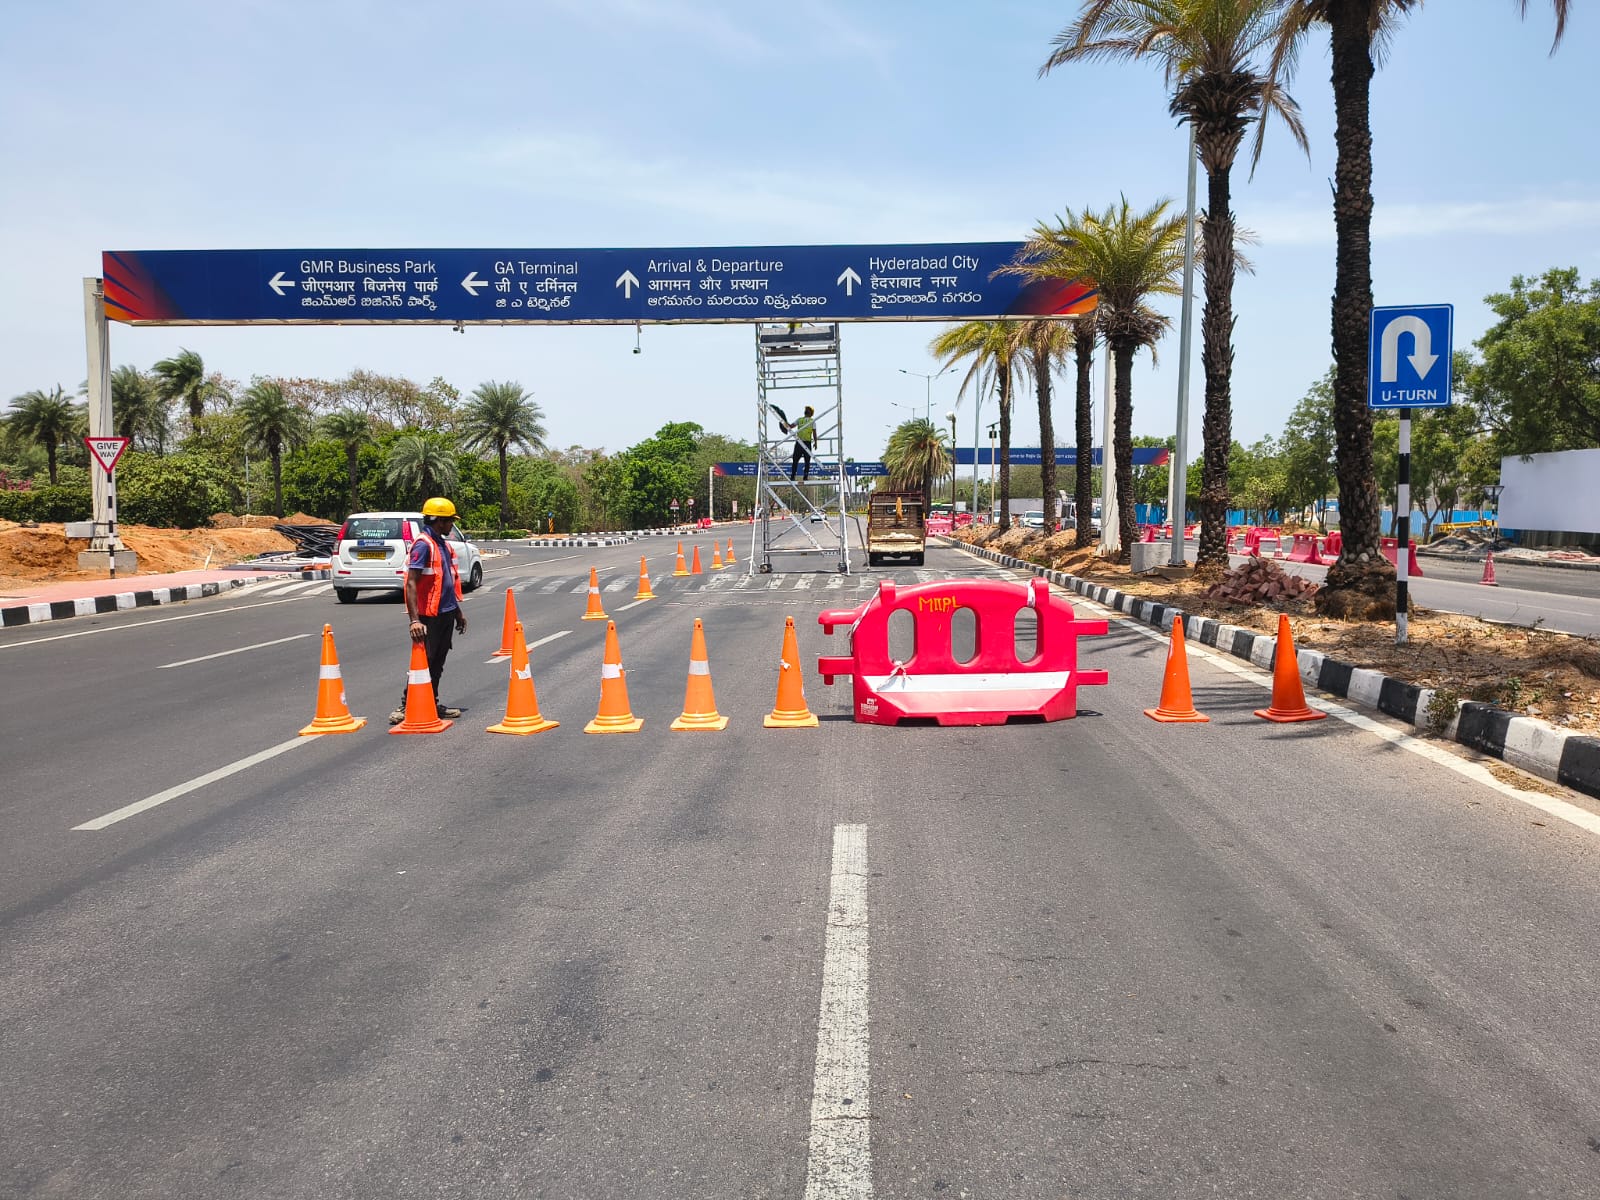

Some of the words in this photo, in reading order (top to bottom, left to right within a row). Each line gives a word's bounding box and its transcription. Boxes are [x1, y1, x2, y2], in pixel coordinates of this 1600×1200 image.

[300, 260, 334, 274] GMR
[338, 260, 401, 274] Business
[404, 260, 436, 274] Park
[494, 261, 515, 275] GA
[518, 261, 578, 275] Terminal
[647, 259, 692, 273] Arrival
[695, 259, 707, 273] &
[711, 258, 784, 275] Departure
[869, 256, 948, 273] Hyderabad
[952, 255, 979, 271] City
[300, 276, 356, 293] जीएमआर
[362, 276, 407, 293] बिजनेस
[413, 276, 439, 293] पार्क
[494, 277, 511, 293] जी
[518, 281, 528, 295] ए
[535, 277, 578, 293] टर्मिनल
[647, 279, 691, 291] आगमन
[698, 275, 723, 291] और
[729, 279, 769, 291] प्रस्थान
[869, 274, 923, 290] हैदराबाद
[929, 276, 958, 288] नगर
[647, 294, 703, 307] ఆగమనం
[706, 294, 759, 306] మరియు
[942, 291, 982, 304] నగరం
[1381, 389, 1437, 402] U-TURN
